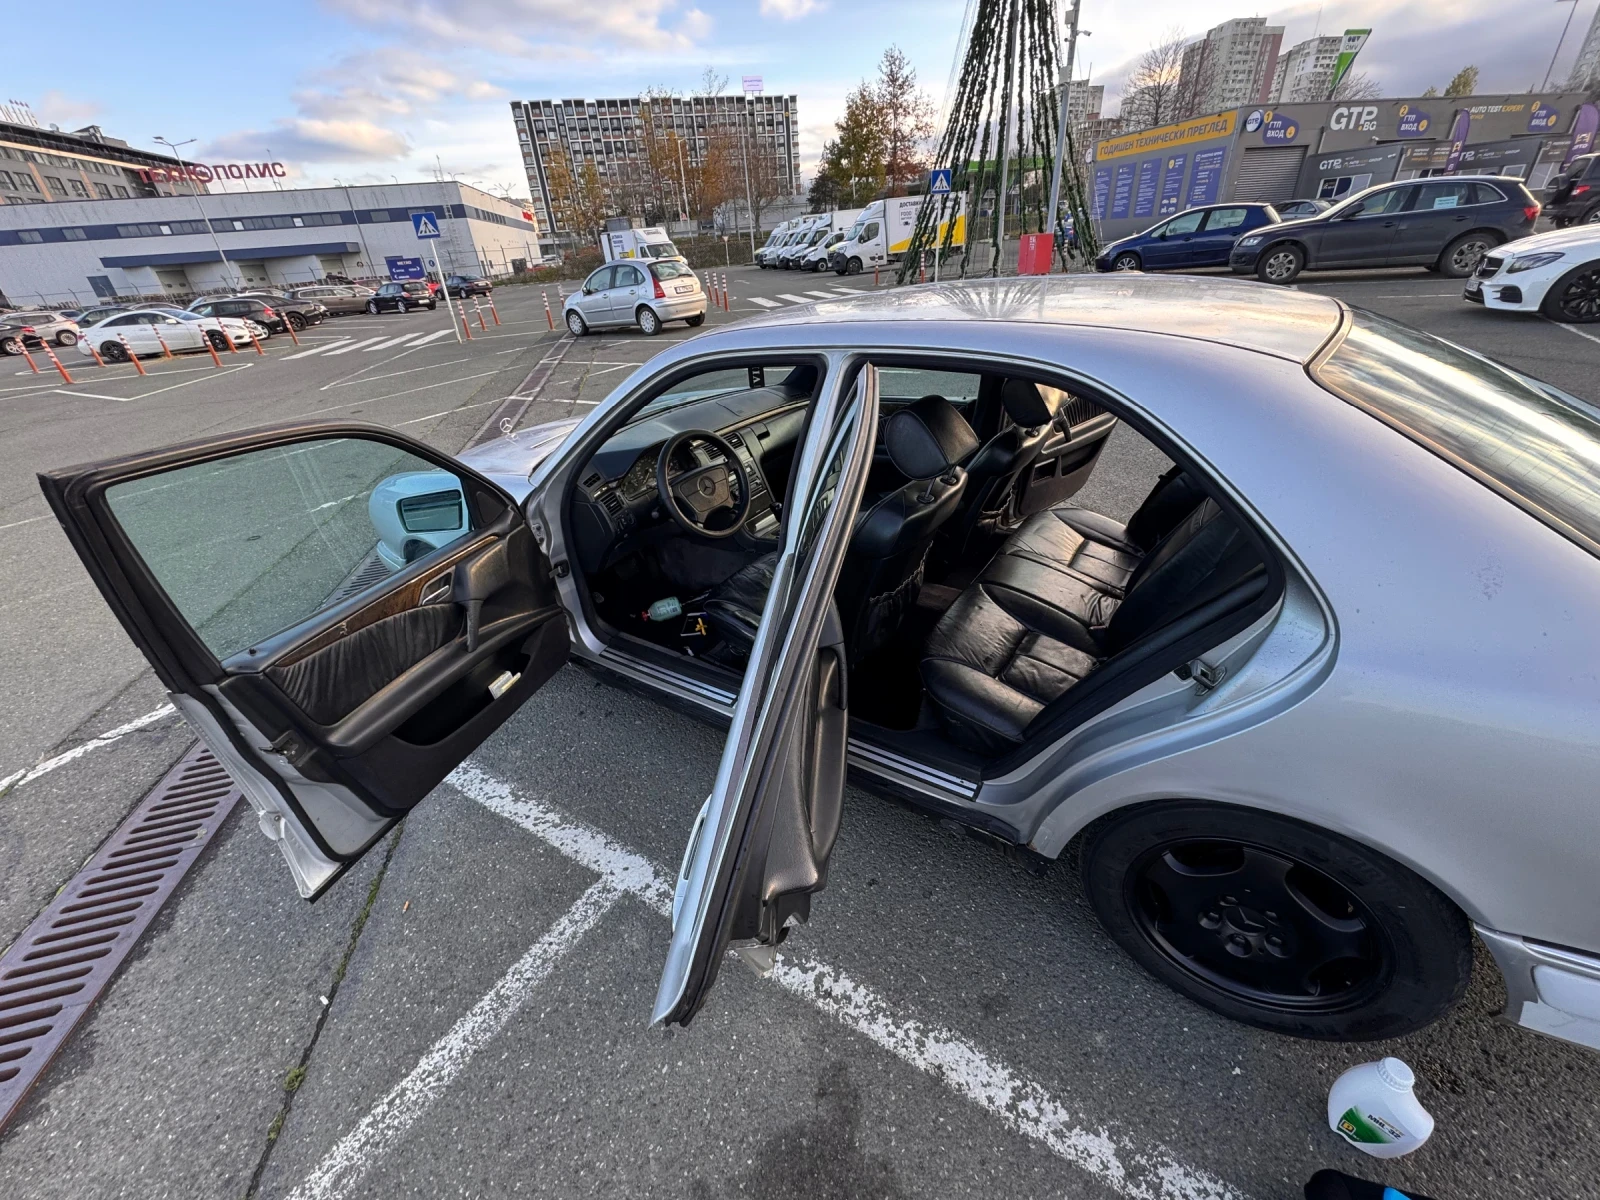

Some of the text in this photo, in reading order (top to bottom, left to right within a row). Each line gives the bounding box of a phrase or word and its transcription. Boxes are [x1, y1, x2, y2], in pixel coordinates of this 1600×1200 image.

[1487, 105, 1502, 113] TEST
[1501, 103, 1525, 112] EXPERT
[1330, 106, 1378, 131] GTP
[1403, 114, 1416, 122] ГТП
[1400, 123, 1418, 131] ВХОД
[1100, 140, 1134, 156] ГОДИШЕН
[1135, 127, 1186, 149] ТЕХНИЧЕСКИ
[1187, 119, 1228, 138] ПРЕГЛЕД
[1266, 129, 1285, 139] ВХОД
[1459, 150, 1475, 161] TP
[1319, 158, 1342, 170] GTP
[136, 162, 286, 183] ТЕХНОПОЛИС
